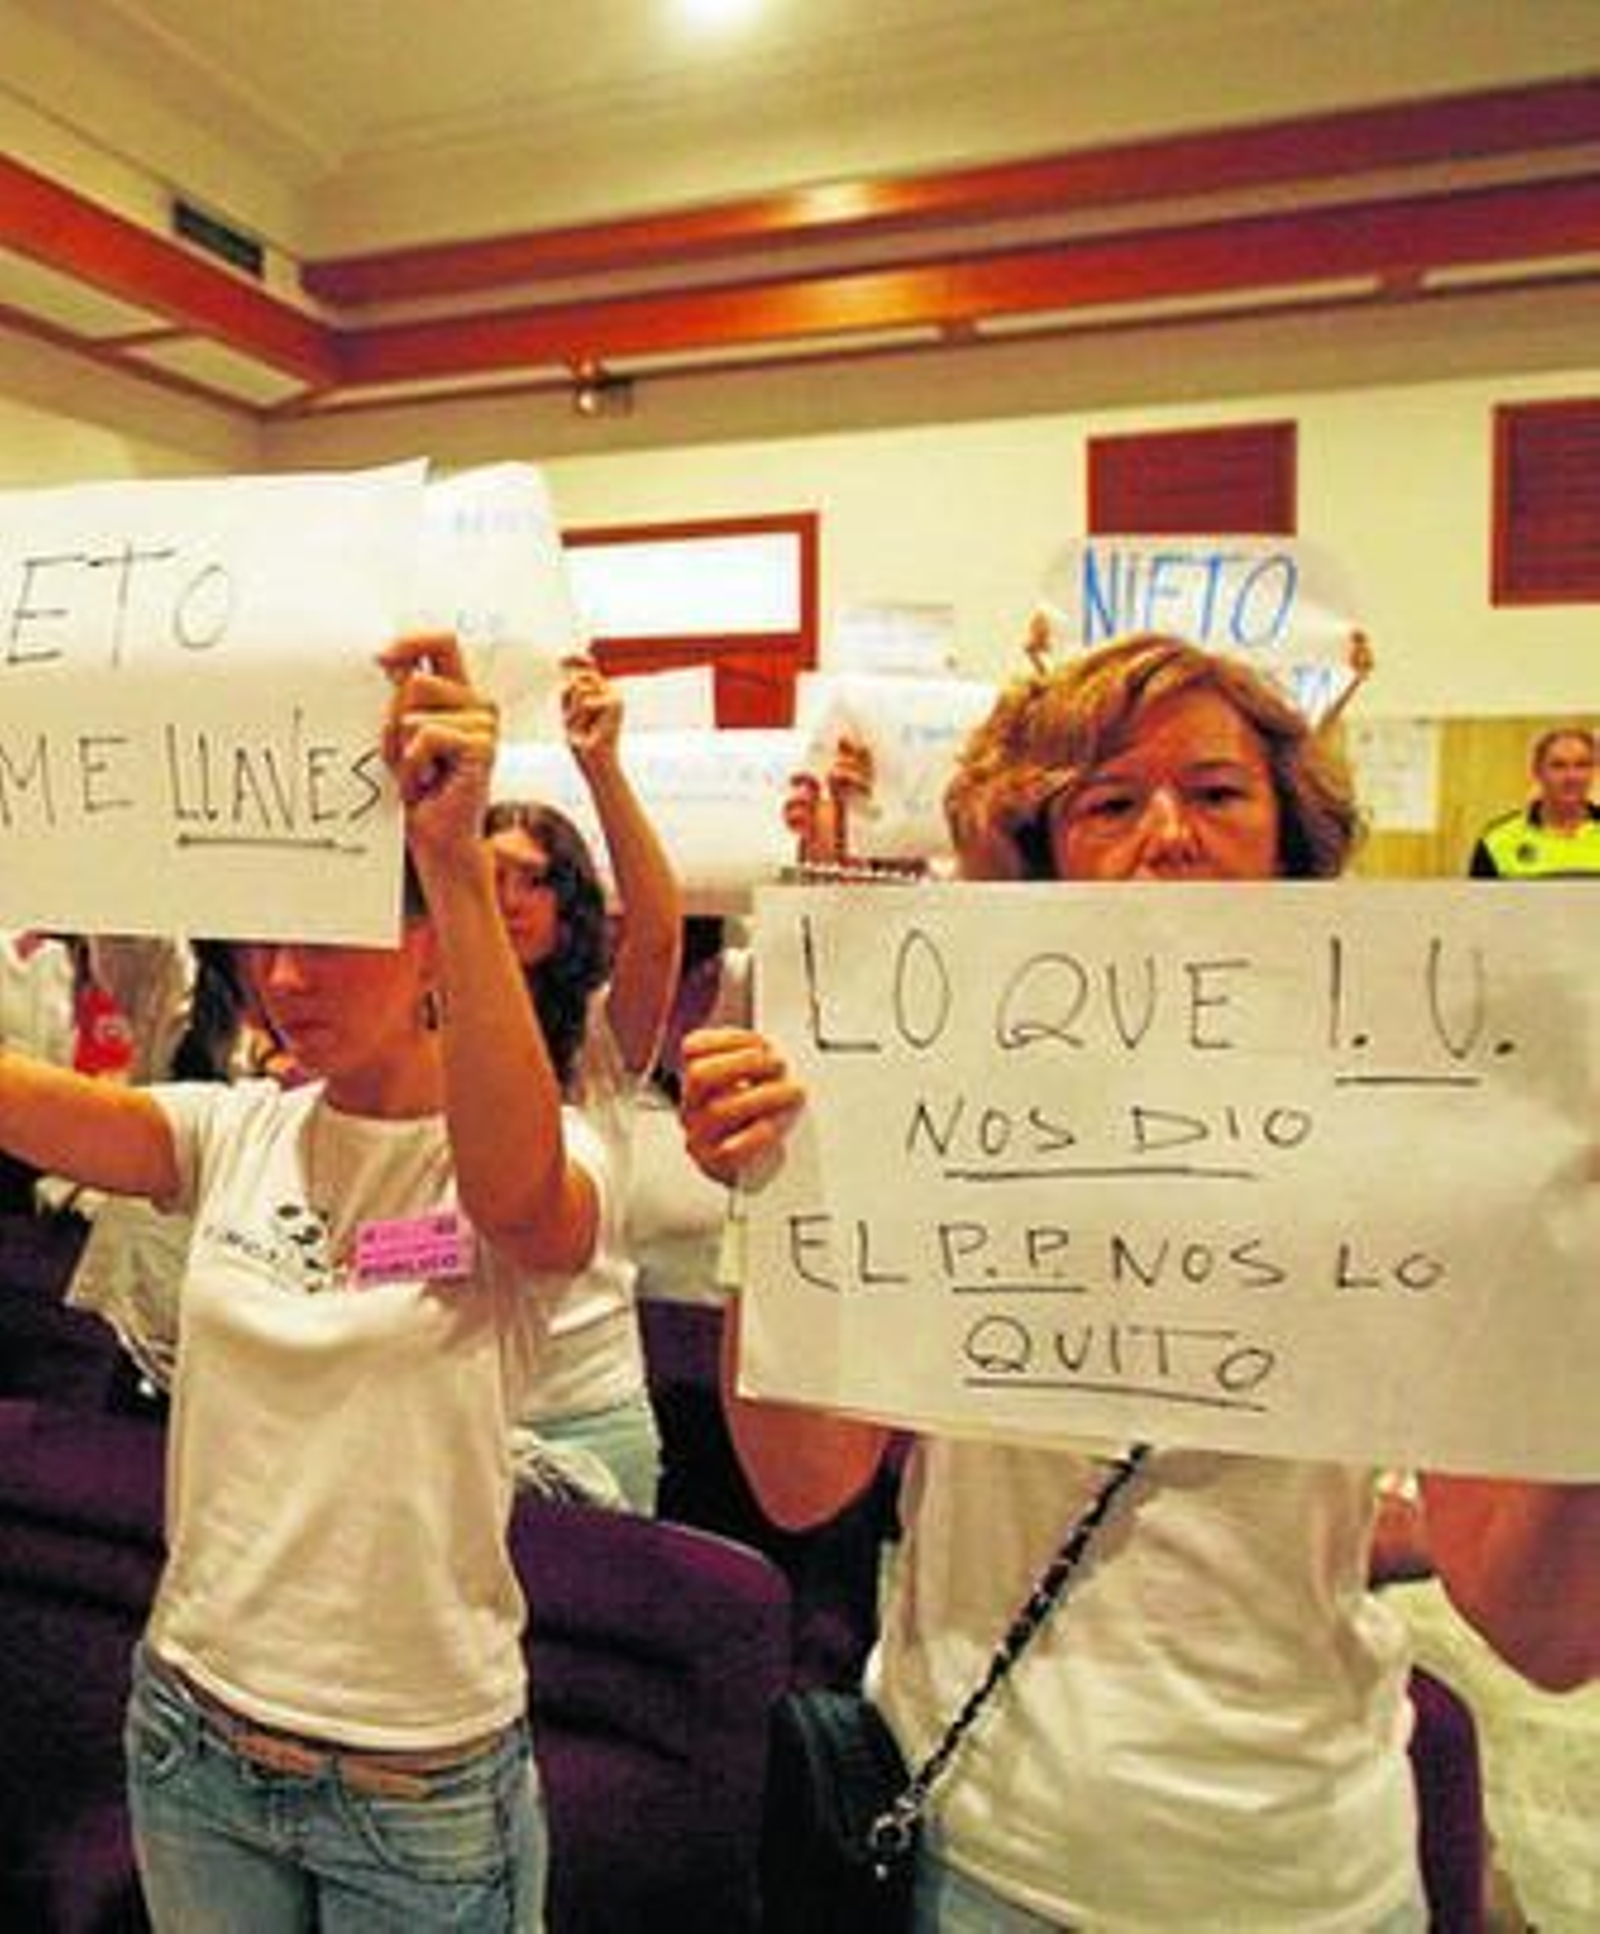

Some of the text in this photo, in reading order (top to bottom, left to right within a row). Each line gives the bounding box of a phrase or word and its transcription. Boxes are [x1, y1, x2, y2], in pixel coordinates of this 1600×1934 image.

[6, 541, 233, 668] ETO
[801, 915, 951, 1051] LO
[996, 952, 1250, 1051] QUE
[905, 1101, 1313, 1157] NOS DIO
[788, 1213, 909, 1293] EL
[1110, 1234, 1288, 1289] NOS
[1333, 1244, 1446, 1290] LO
[963, 1314, 1276, 1393] QUITO
